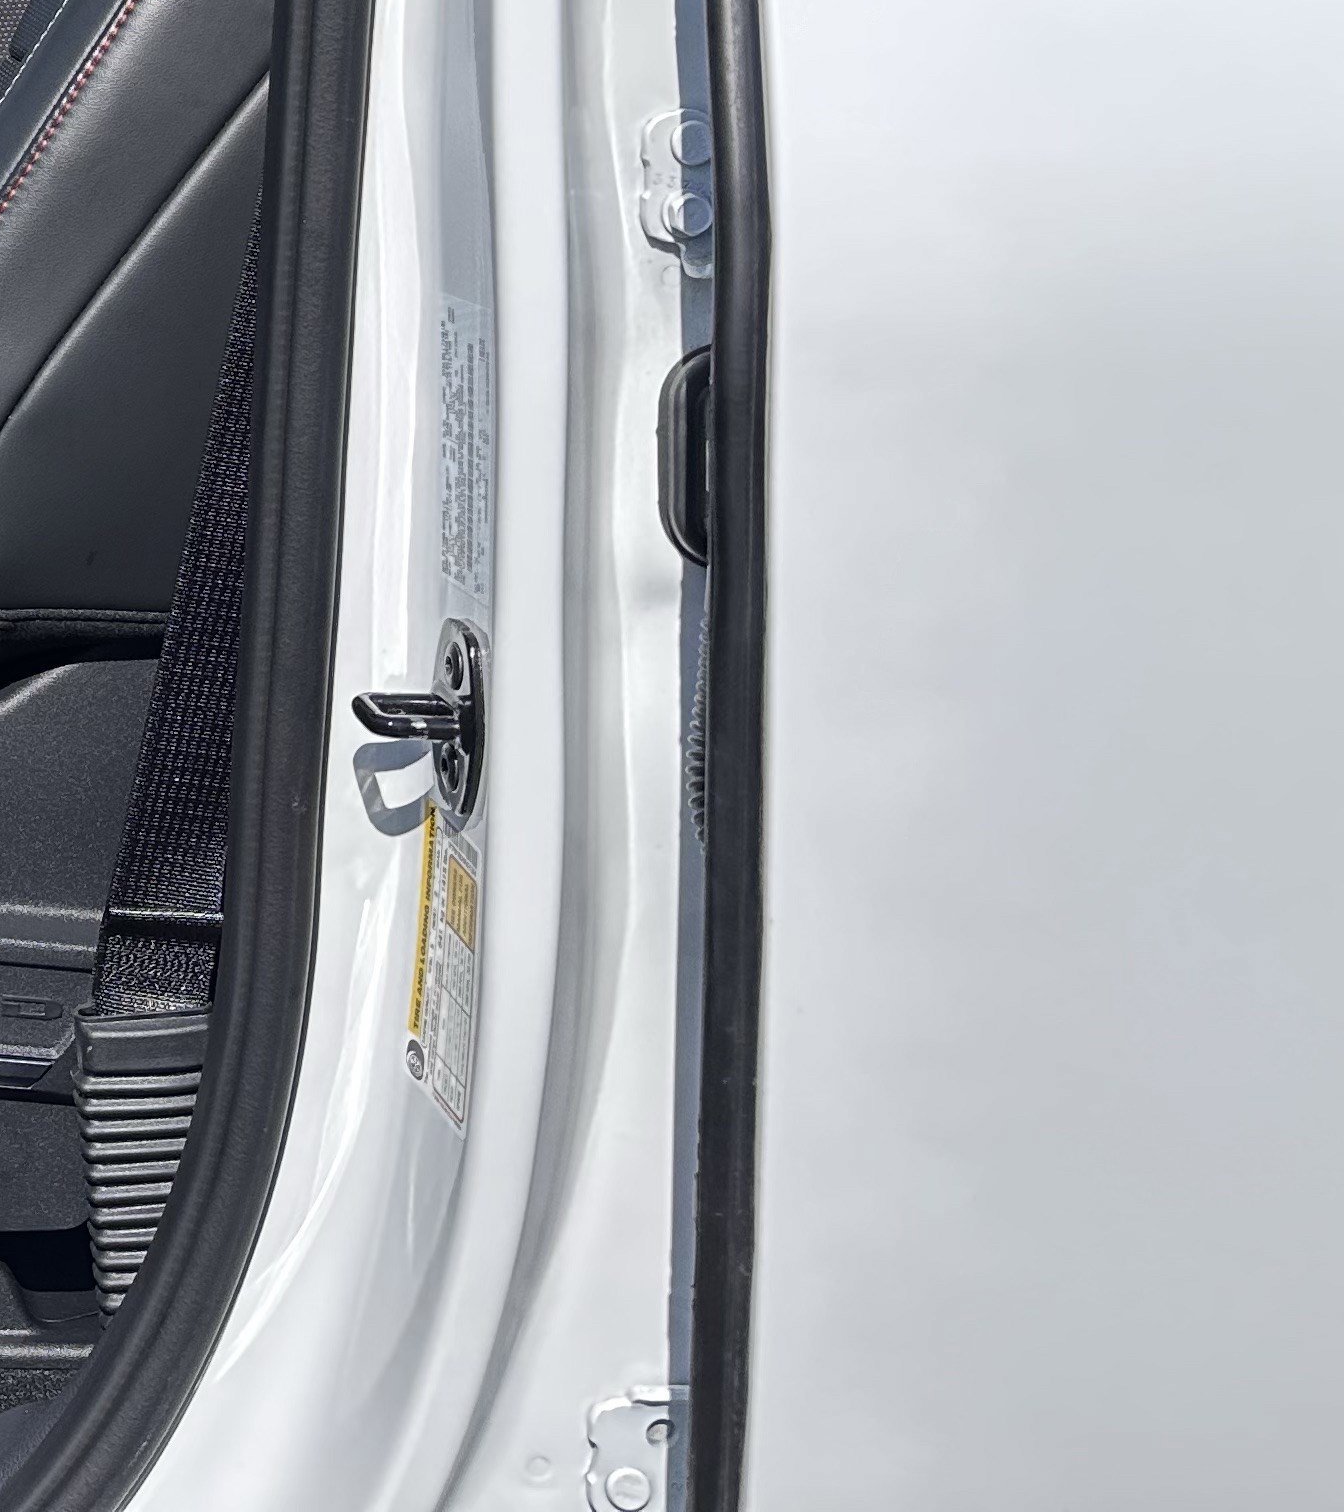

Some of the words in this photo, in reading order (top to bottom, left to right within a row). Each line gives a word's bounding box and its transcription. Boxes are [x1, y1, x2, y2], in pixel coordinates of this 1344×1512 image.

[425, 806, 436, 901] INFORMATION
[419, 905, 430, 965] LOADING
[416, 967, 425, 997] AND
[413, 999, 421, 1029] TIRE
